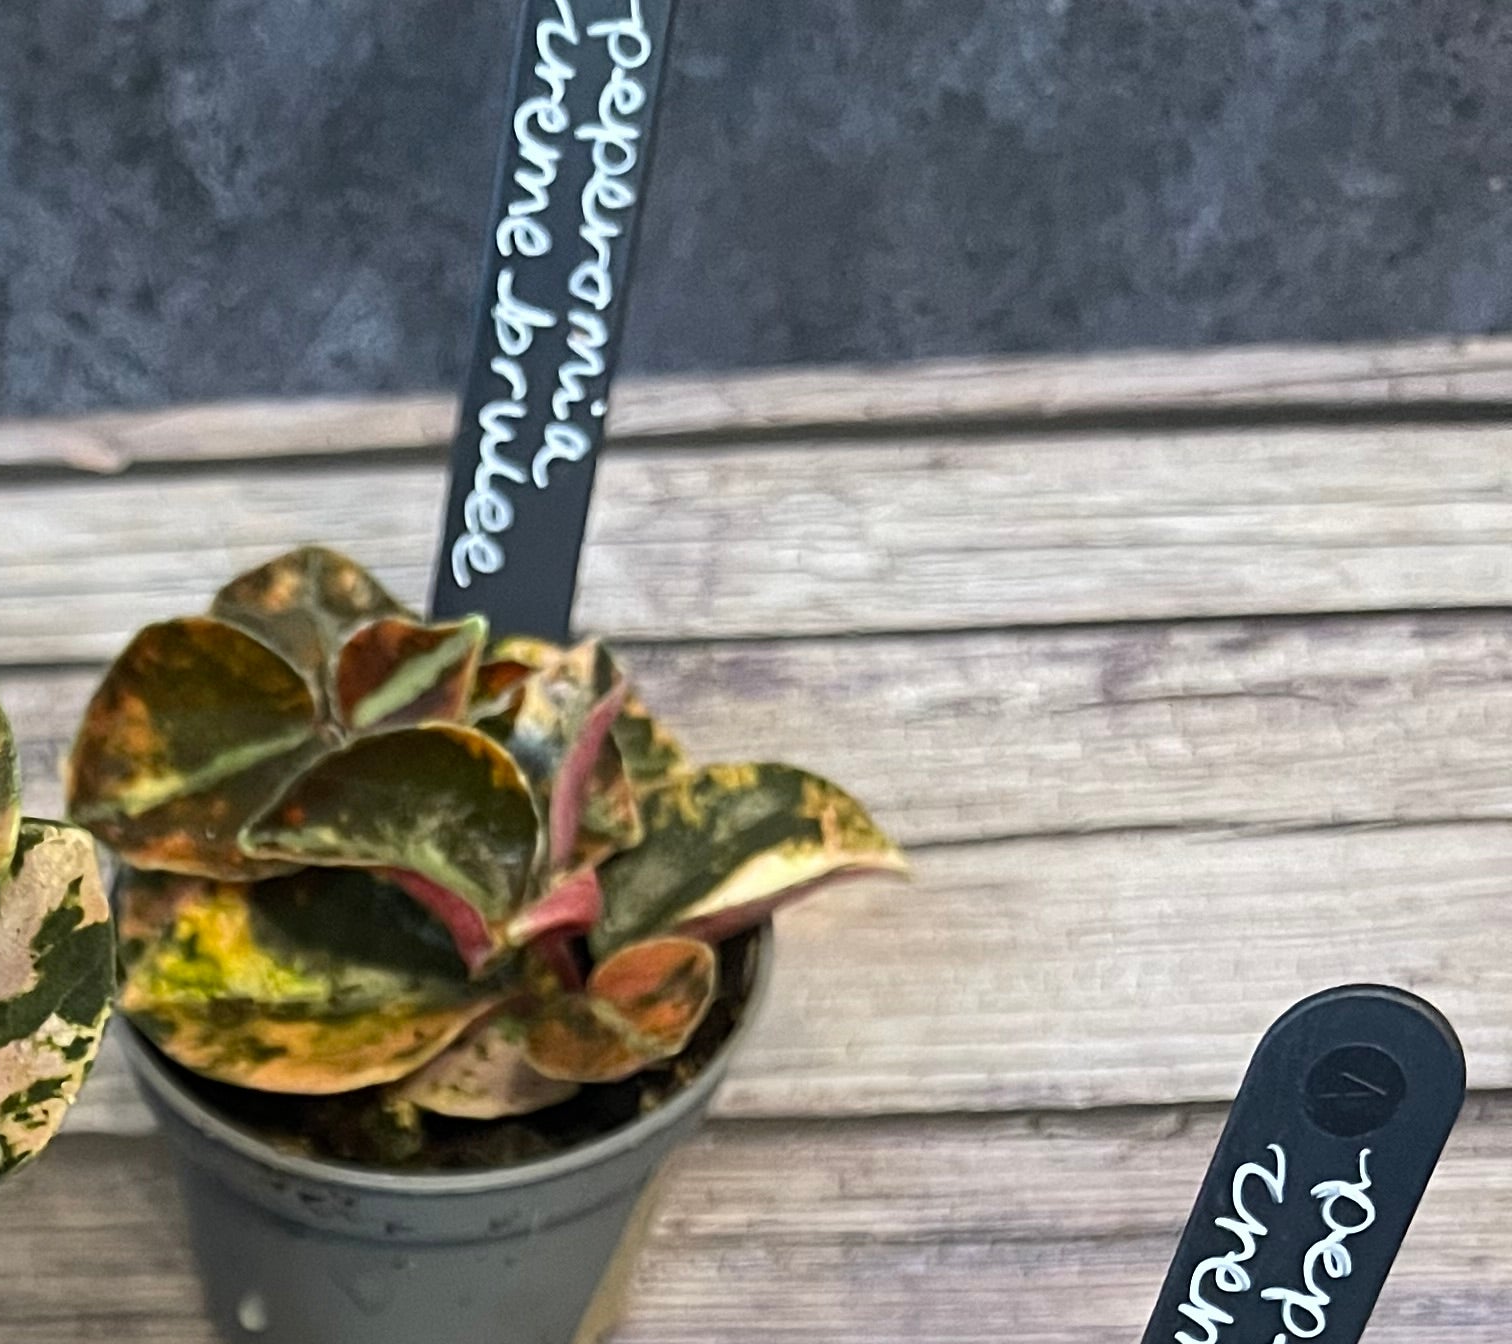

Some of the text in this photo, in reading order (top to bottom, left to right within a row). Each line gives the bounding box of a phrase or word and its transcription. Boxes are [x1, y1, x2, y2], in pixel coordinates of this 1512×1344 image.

[451, 0, 581, 589] creme brulee
[533, 0, 652, 489] peperomia
